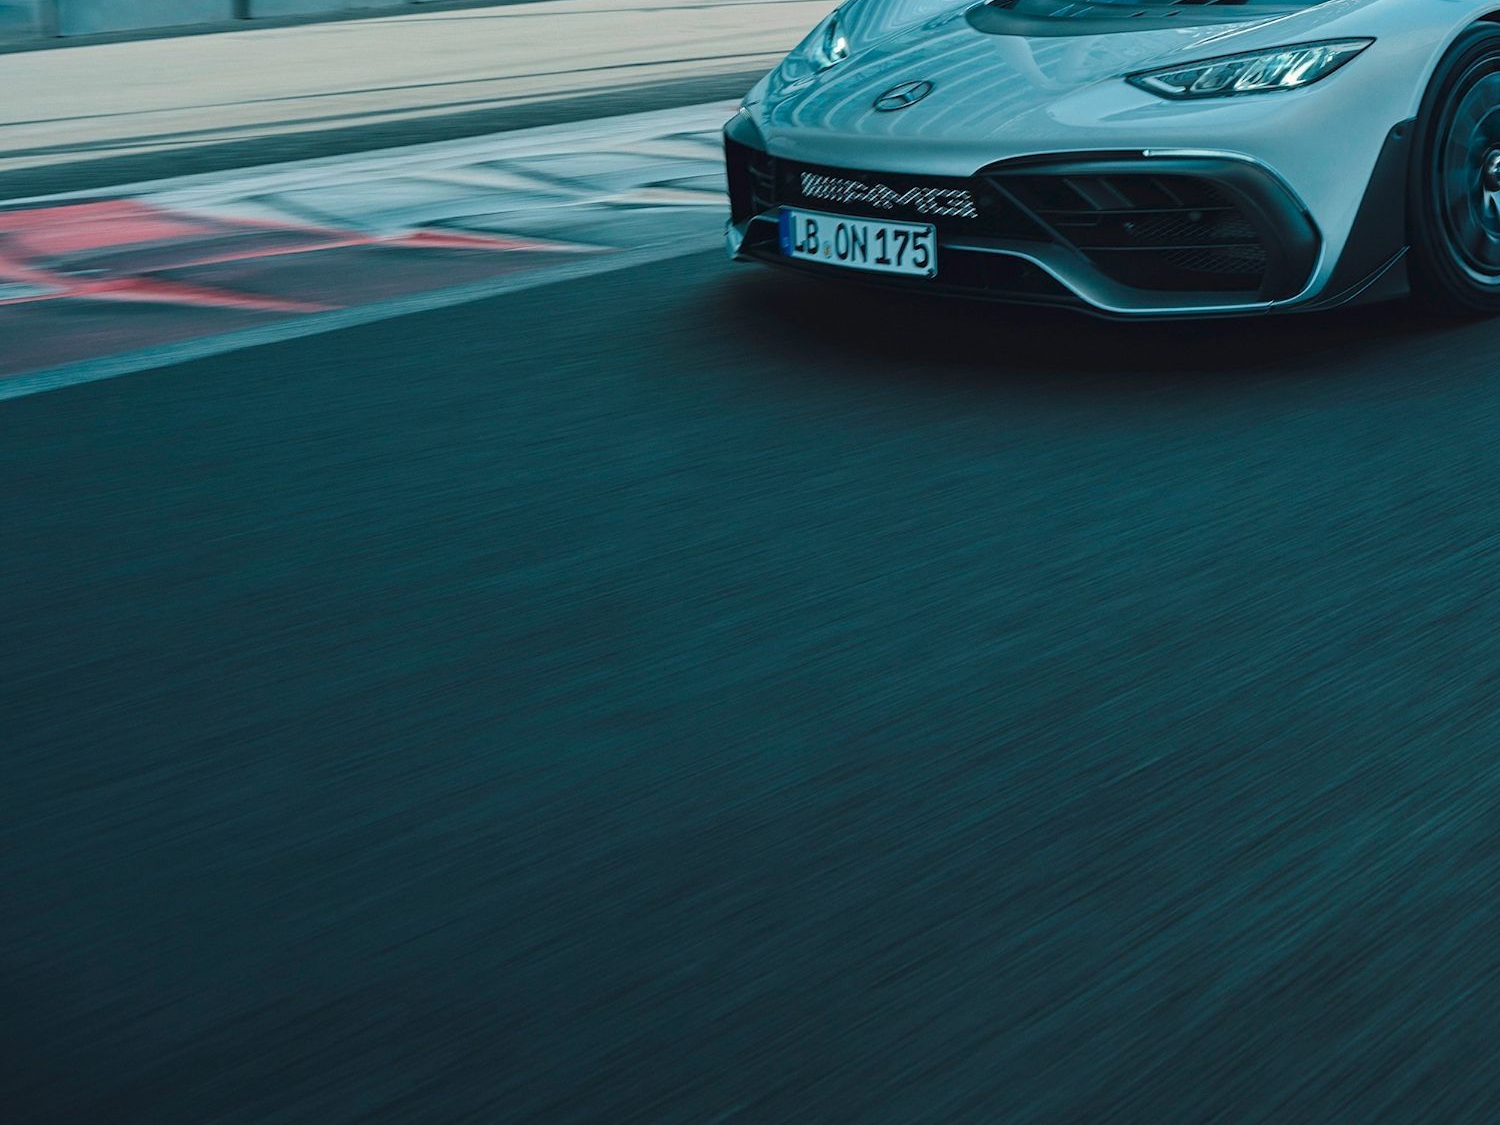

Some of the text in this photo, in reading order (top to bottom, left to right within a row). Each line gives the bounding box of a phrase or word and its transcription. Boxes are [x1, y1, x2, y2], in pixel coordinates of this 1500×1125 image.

[843, 178, 978, 218] AMG
[793, 215, 931, 268] LB ON 175
